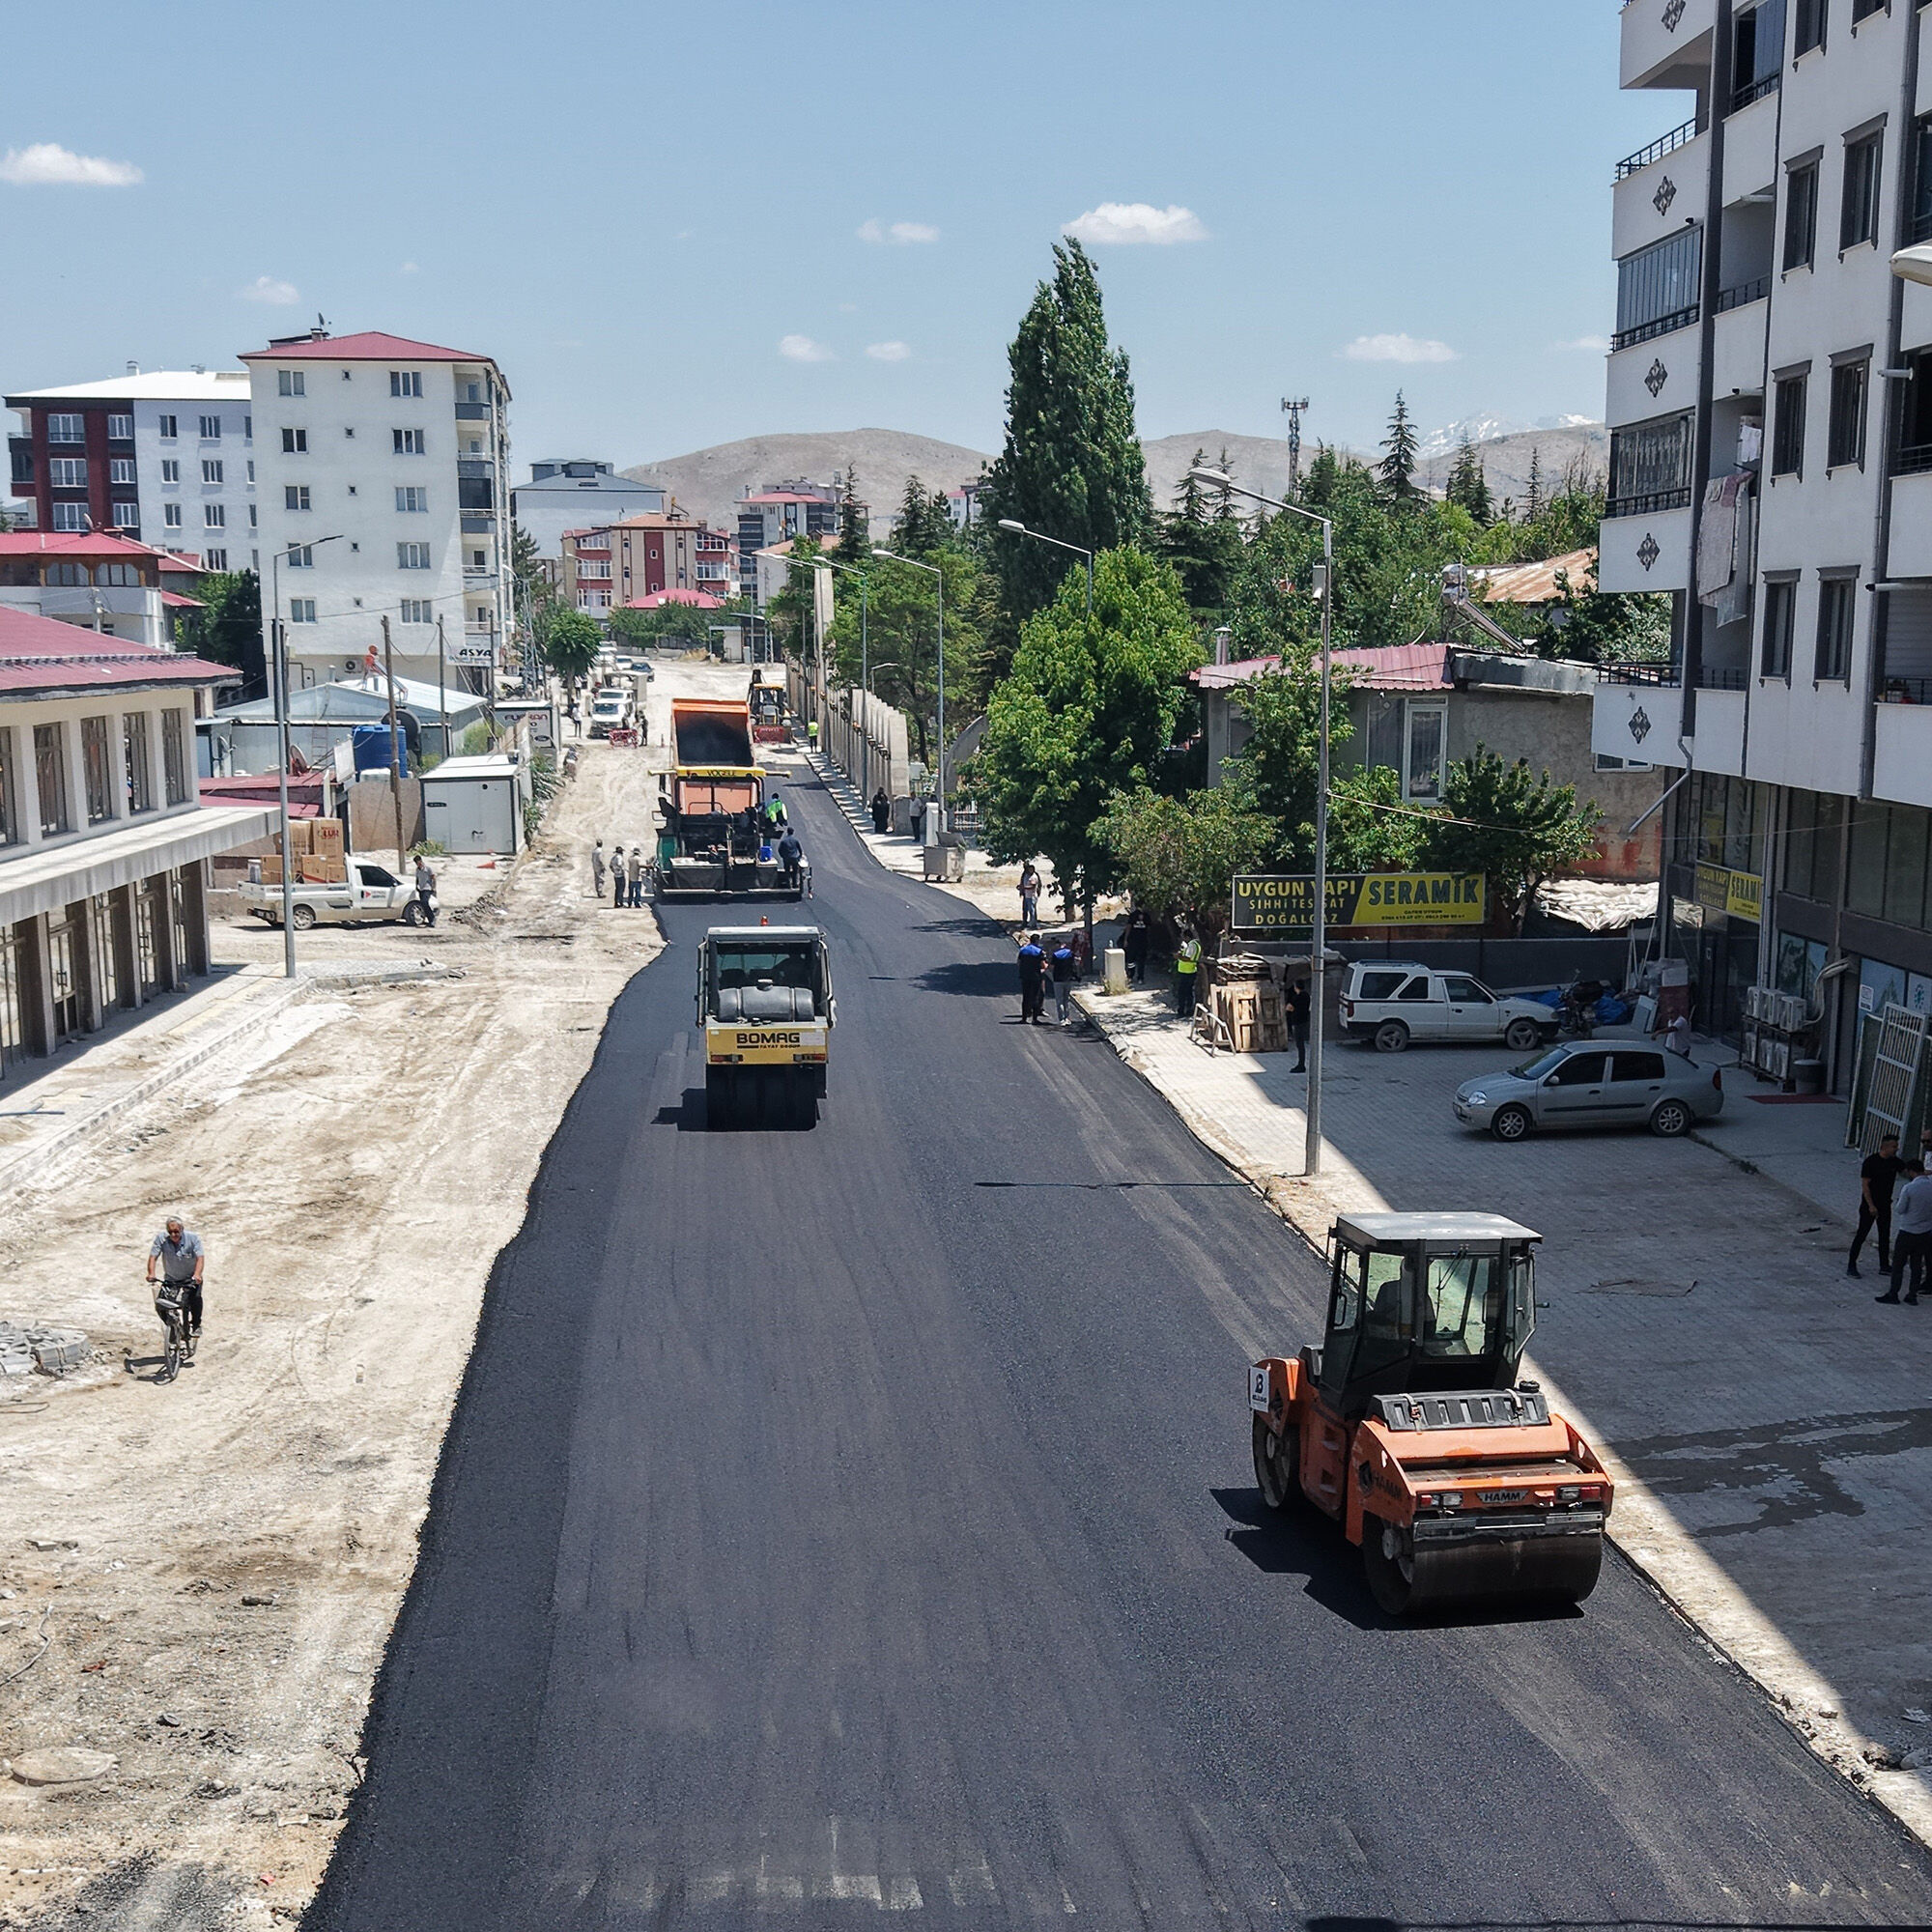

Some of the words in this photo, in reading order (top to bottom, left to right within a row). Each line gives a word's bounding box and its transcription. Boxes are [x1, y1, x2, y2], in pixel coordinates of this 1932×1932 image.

[459, 648, 492, 657] ASYA
[1238, 880, 1305, 897] UYGUN
[1369, 878, 1479, 905] SERAMİK
[736, 1032, 801, 1044] BOMAG
[1484, 1492, 1521, 1501] HAMM
